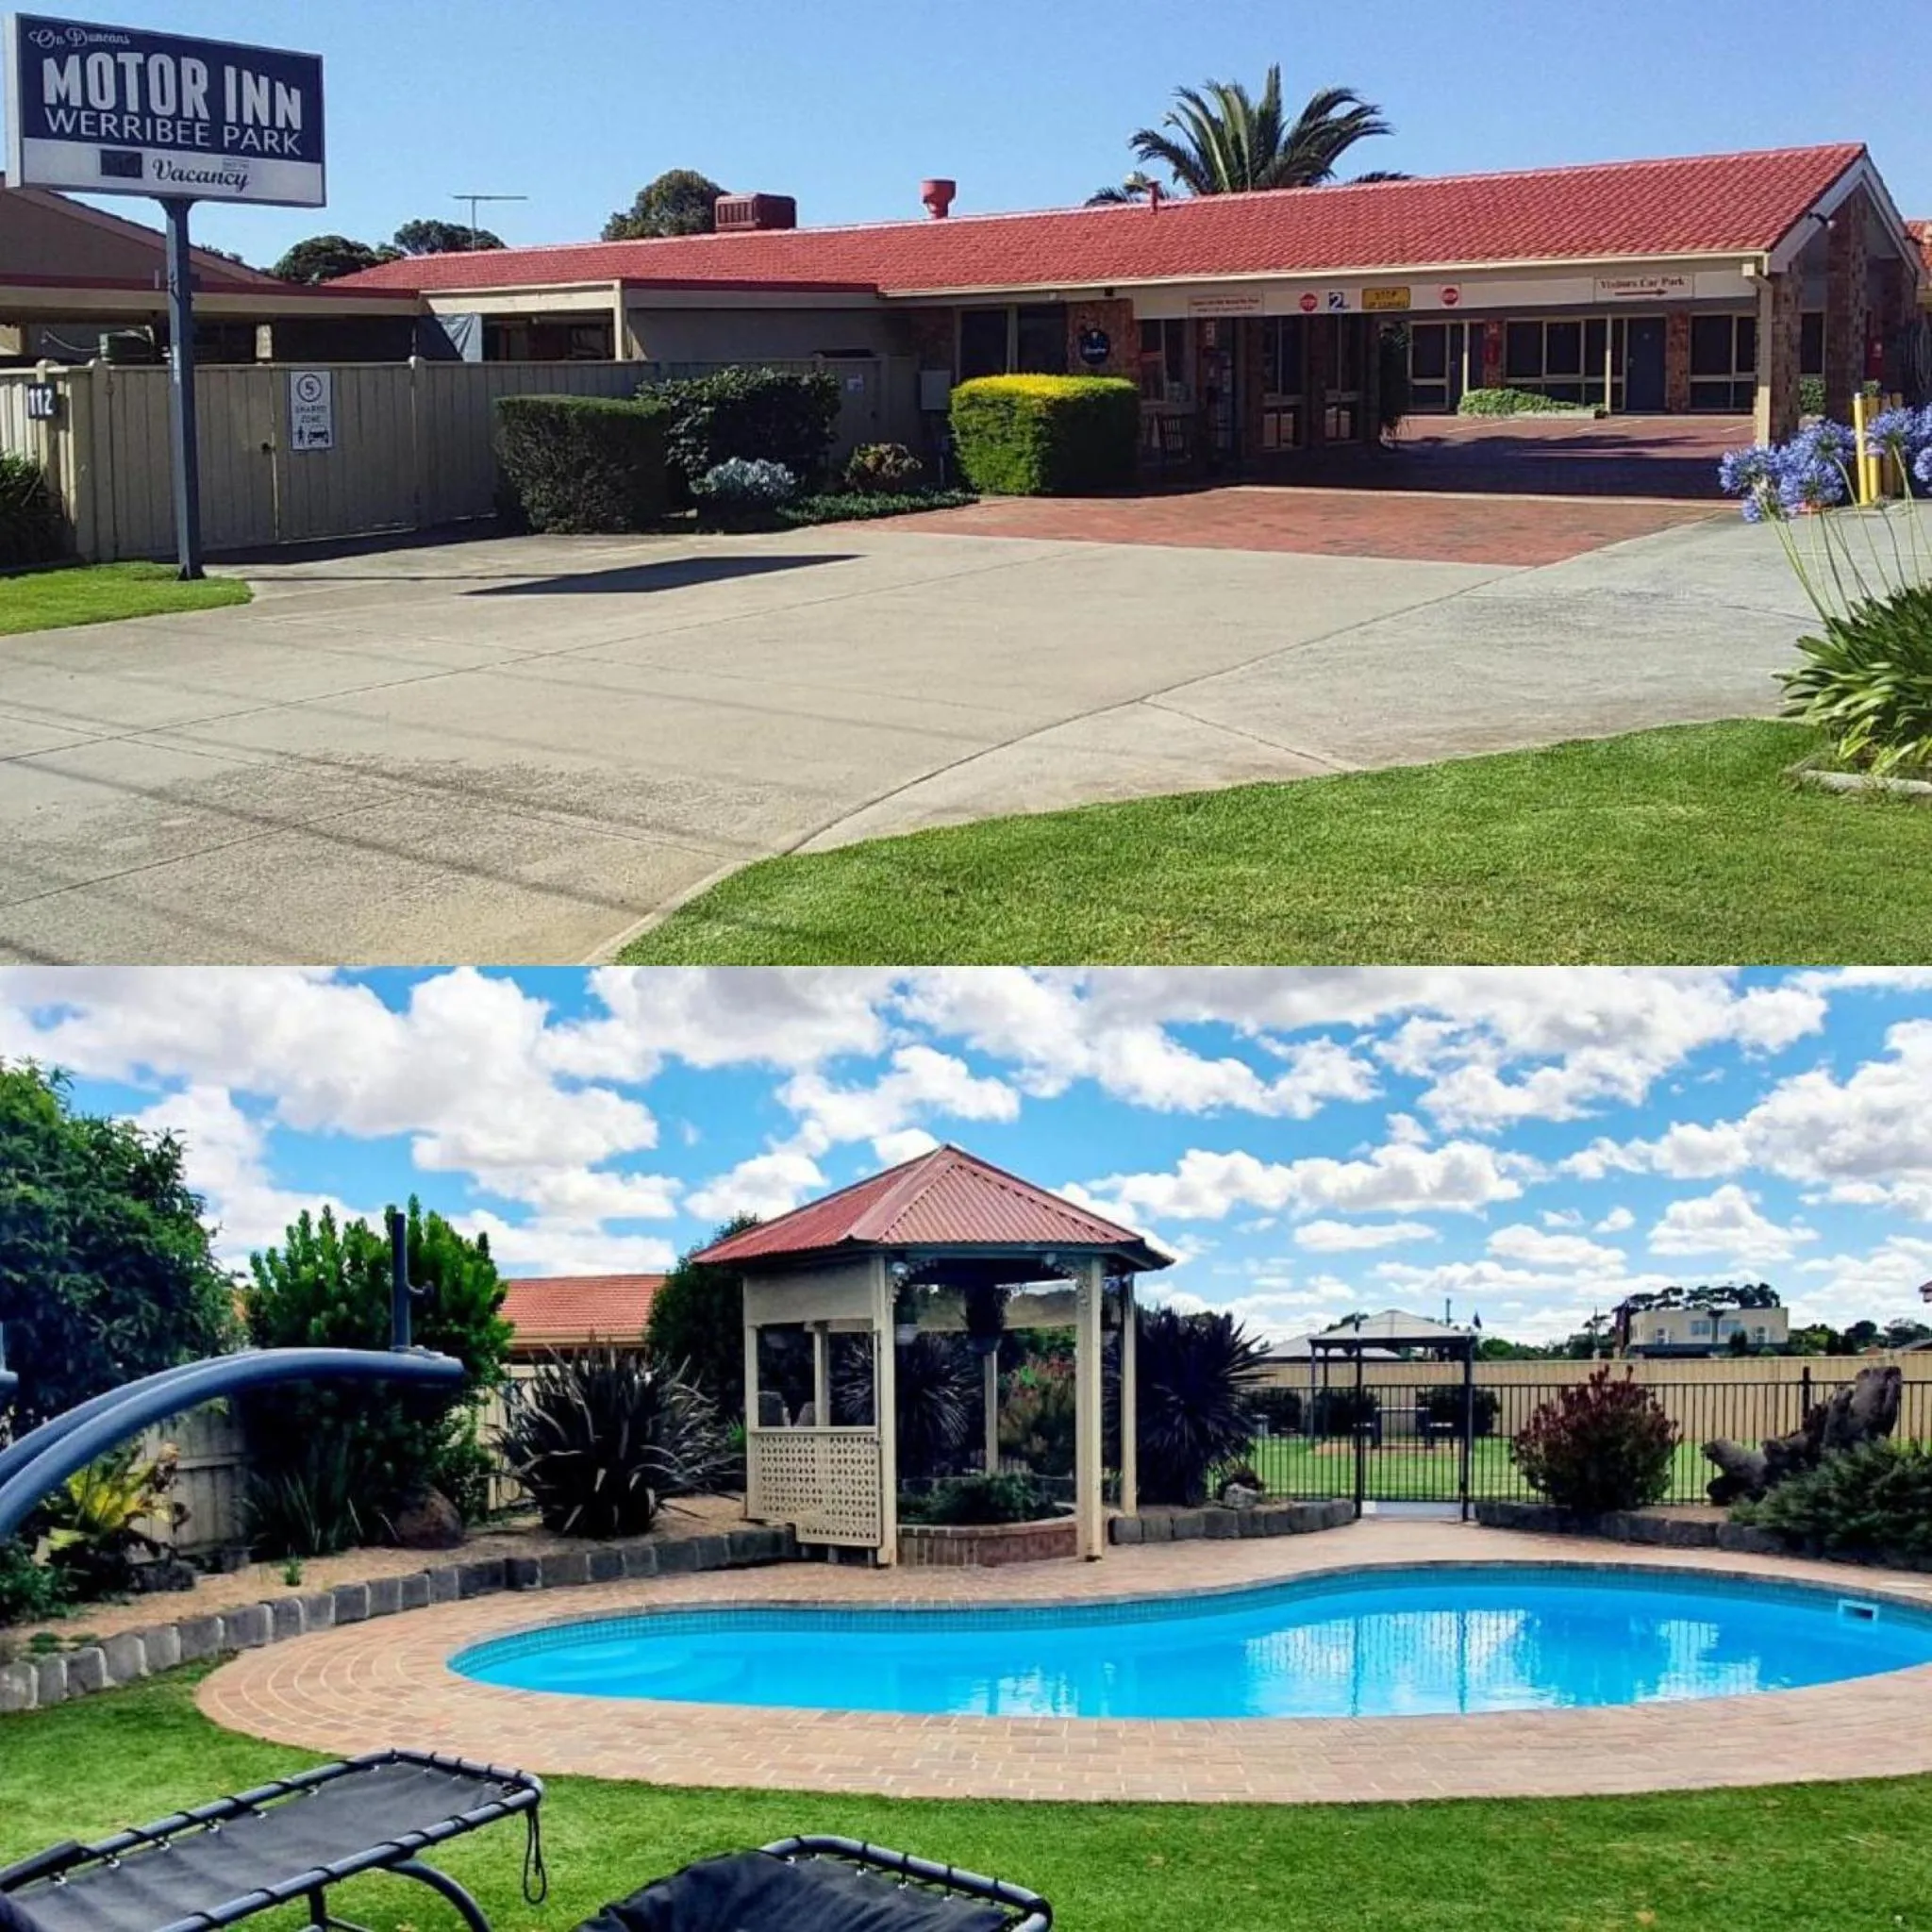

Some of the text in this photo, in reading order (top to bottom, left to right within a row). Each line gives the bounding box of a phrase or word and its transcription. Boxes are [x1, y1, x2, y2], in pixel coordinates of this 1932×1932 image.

[42, 52, 302, 130] MOTOR INN
[44, 107, 303, 156] WERRIBEE PARK
[152, 158, 249, 192] Vacancy
[1660, 276, 1685, 286] Park
[29, 388, 54, 415] 112
[305, 380, 315, 395] 5
